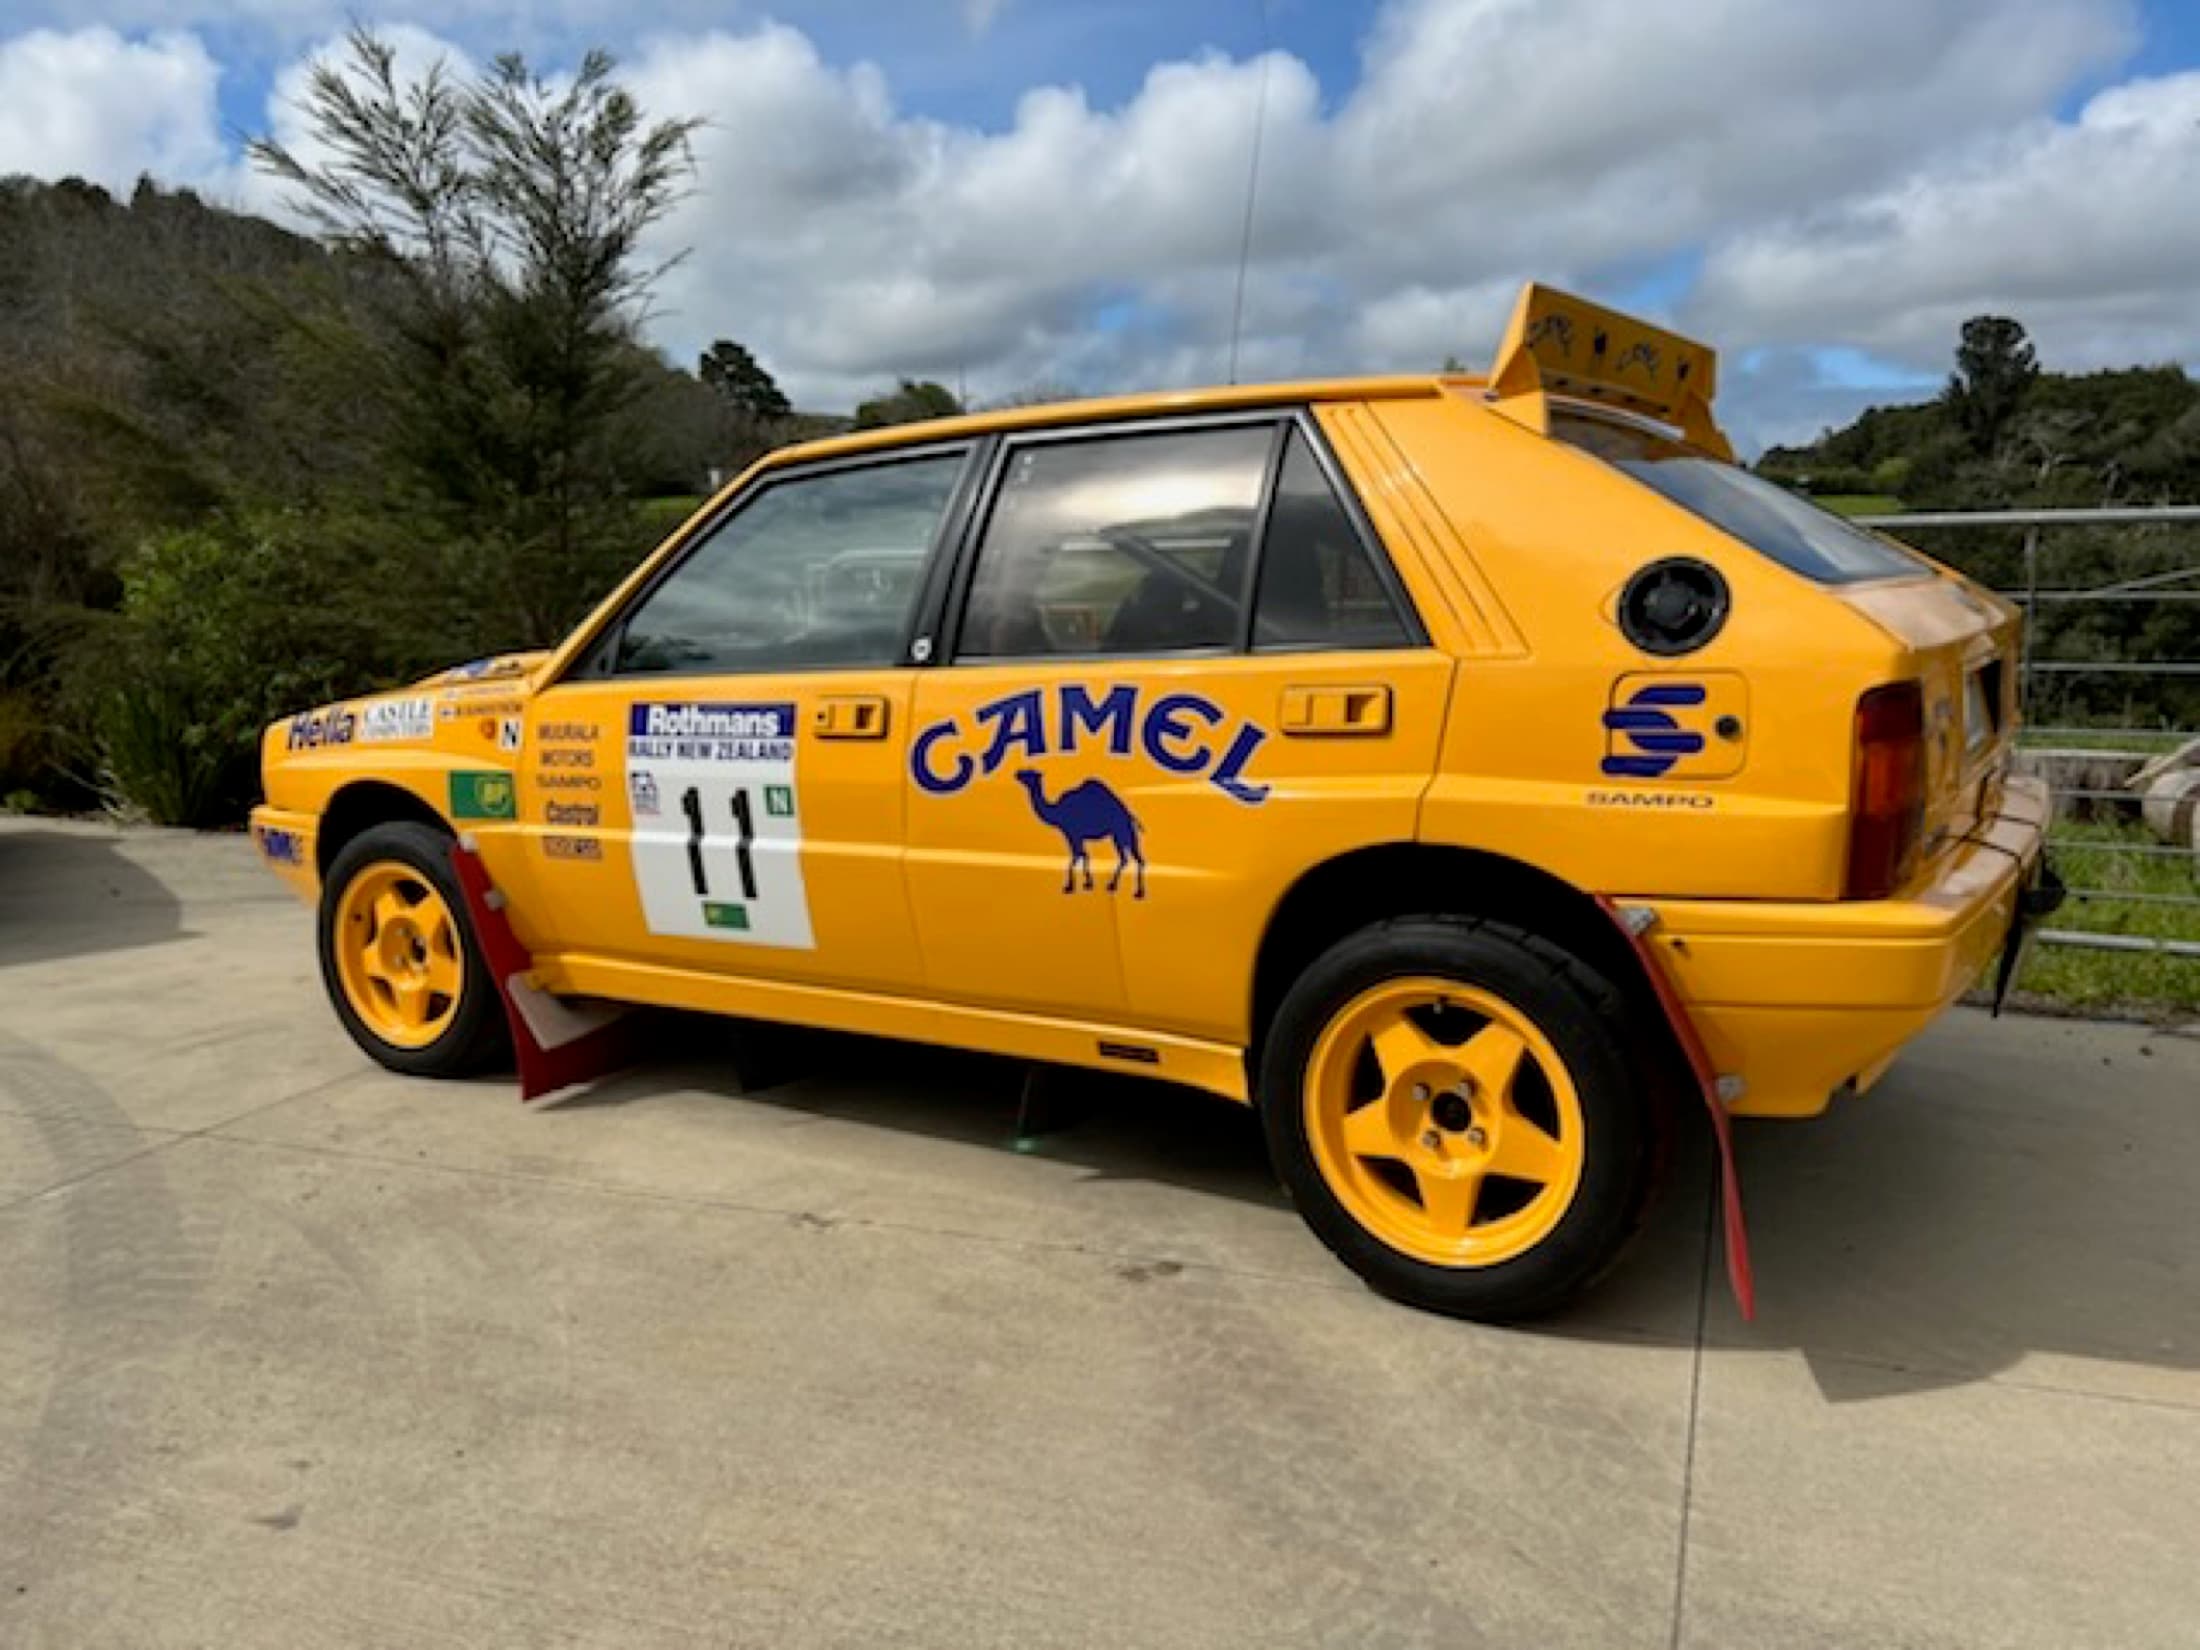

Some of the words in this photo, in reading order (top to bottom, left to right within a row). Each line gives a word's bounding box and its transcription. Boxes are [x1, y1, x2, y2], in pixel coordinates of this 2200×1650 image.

[502, 720, 519, 747] N
[648, 704, 779, 737] Rothmans
[629, 741, 672, 757] RALLY
[677, 741, 712, 758] NEW
[717, 742, 793, 760] ZEALAND
[910, 685, 1271, 804] CAMEL
[1587, 791, 1714, 808] SAMPO
[682, 786, 757, 899] 11
